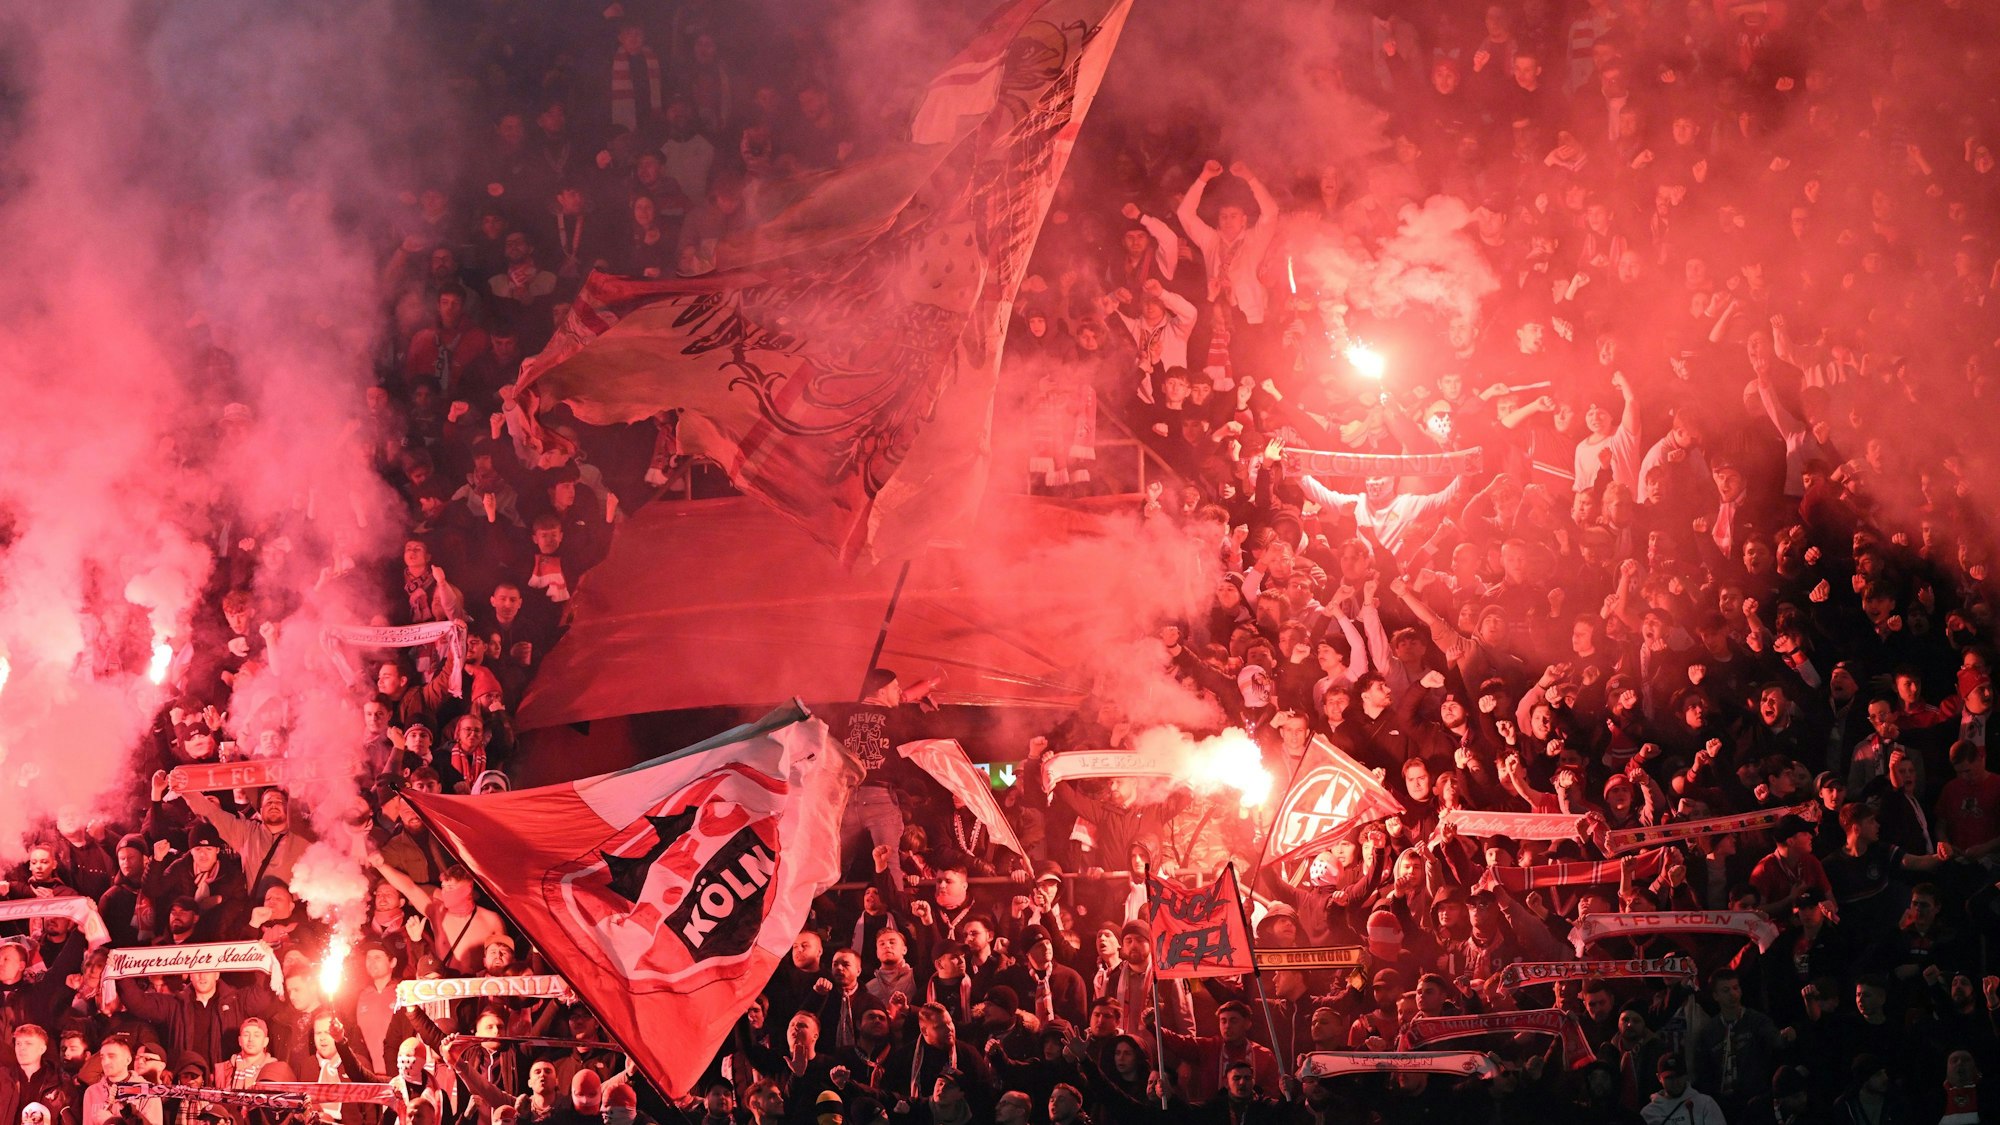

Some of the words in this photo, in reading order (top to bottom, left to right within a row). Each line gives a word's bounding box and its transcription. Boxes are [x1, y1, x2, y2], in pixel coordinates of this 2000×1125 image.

[1310, 453, 1456, 475] COLONIA
[848, 712, 886, 726] NEVER
[879, 737, 890, 749] 12
[207, 770, 223, 787] 1.
[231, 766, 256, 785] FC
[264, 763, 316, 782] KN
[682, 844, 775, 949] KÖLN
[1147, 878, 1231, 923] FUCK
[1613, 916, 1628, 927] 1.
[1634, 914, 1661, 926] FC
[1674, 911, 1732, 925] KÖLN
[1156, 919, 1237, 972] UEFA
[1286, 950, 1352, 963] DORTMUND
[113, 949, 213, 975] Müngersdorfer
[214, 945, 266, 968] Stadion
[413, 975, 564, 1000] COLONIA
[1440, 1018, 1488, 1032] IMMER
[1527, 1011, 1568, 1031] KÖLN
[1361, 1055, 1380, 1065] FC
[1387, 1053, 1433, 1066] KÖLN
